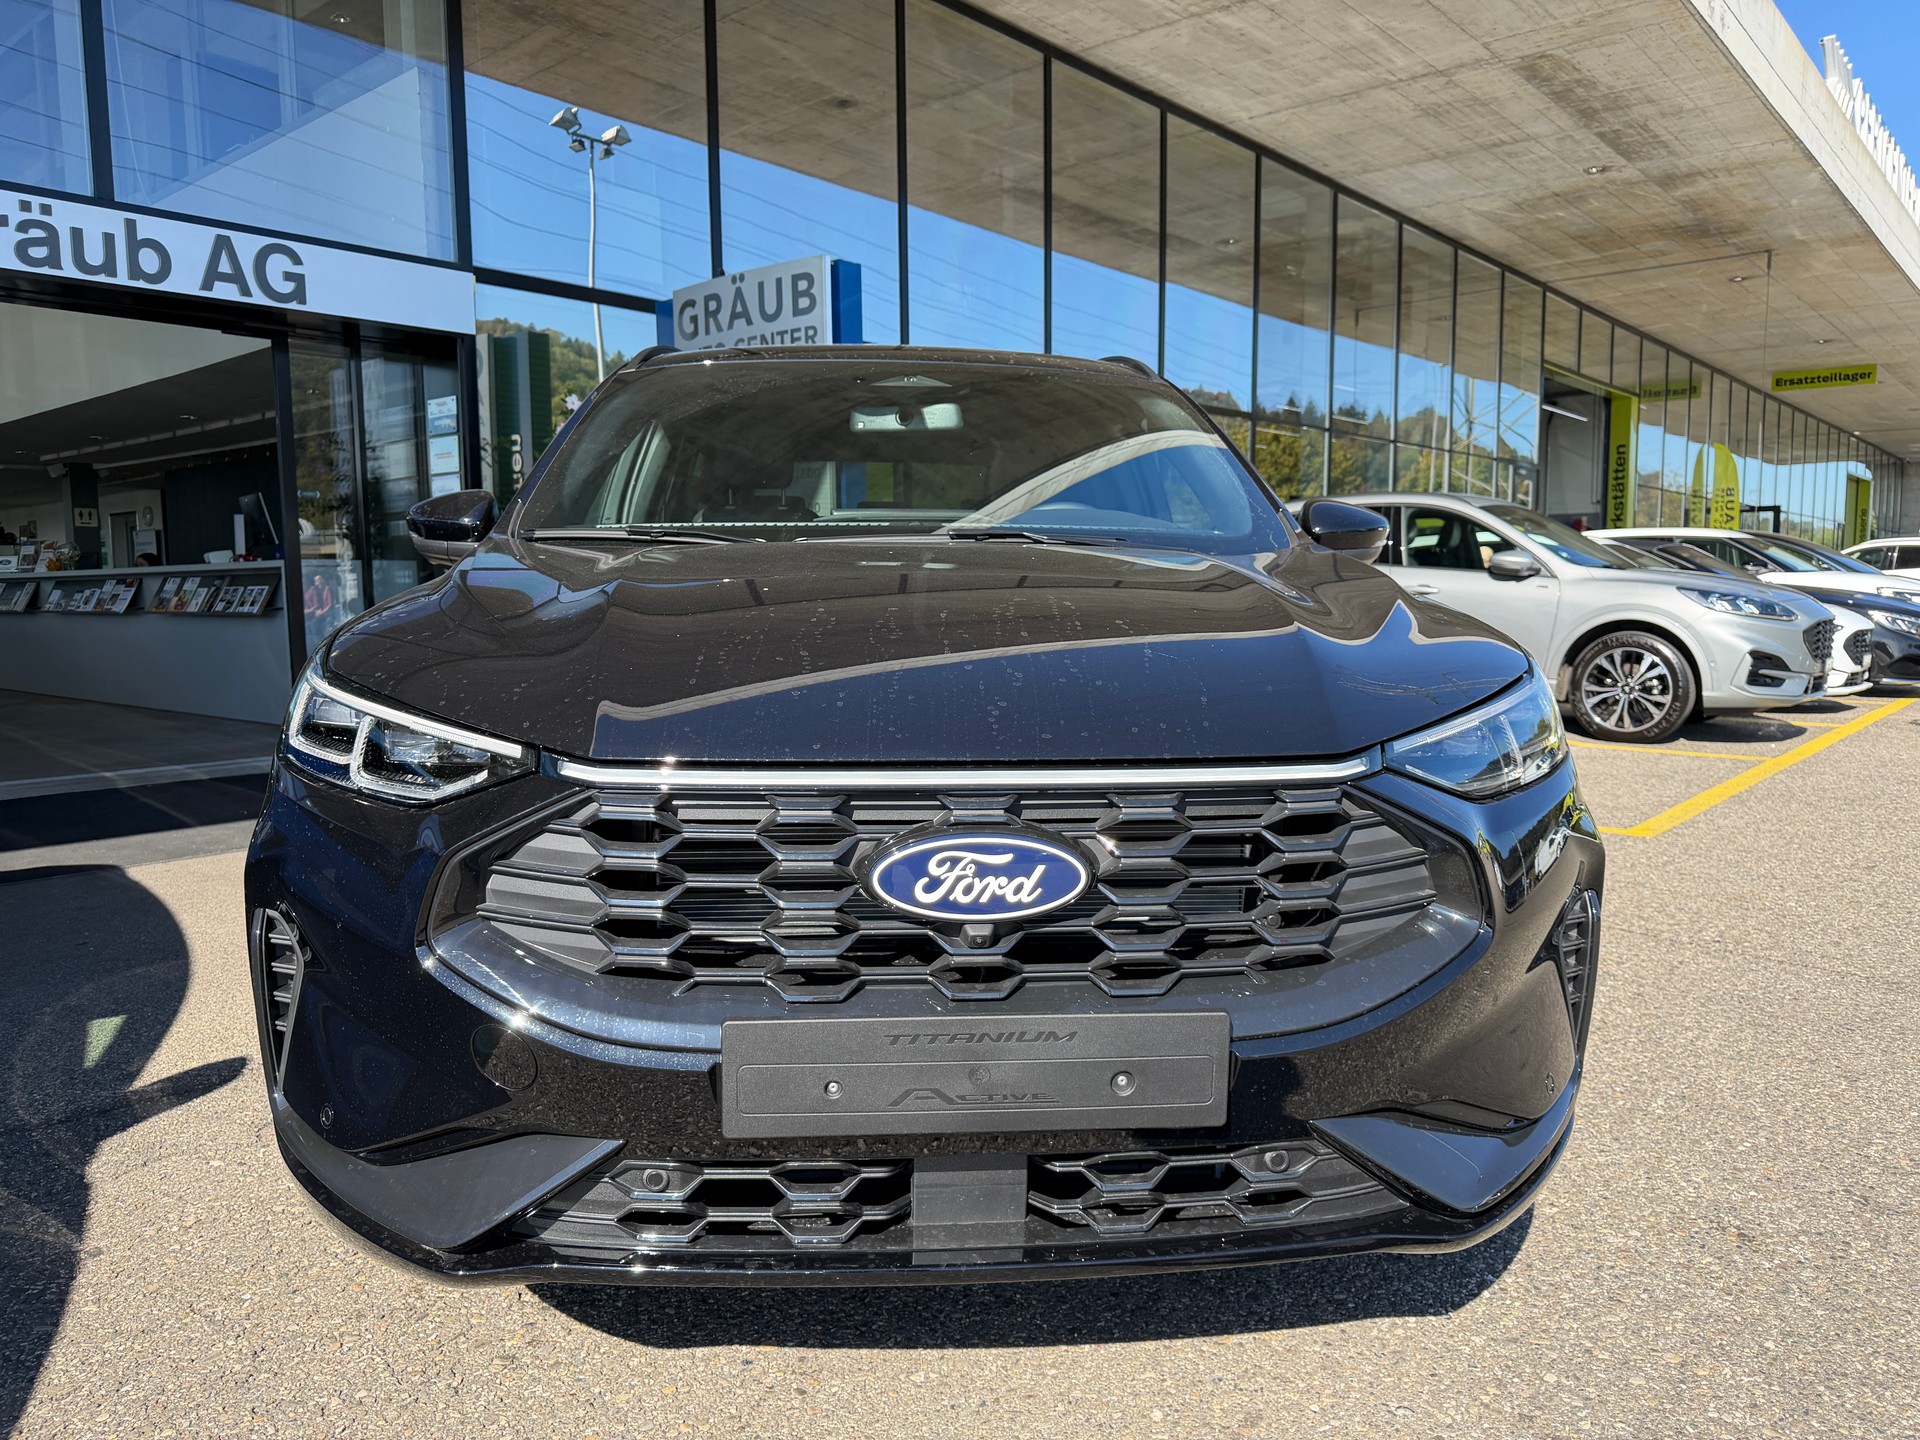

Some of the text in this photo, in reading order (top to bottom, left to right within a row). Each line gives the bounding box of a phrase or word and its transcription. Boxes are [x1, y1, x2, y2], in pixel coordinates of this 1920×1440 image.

[0, 199, 307, 305] äub AG
[678, 272, 817, 341] GRÄUB
[1775, 371, 1873, 387] Ersatzteillager
[914, 850, 1046, 904] Ford
[884, 1031, 1079, 1046] TITANIUM
